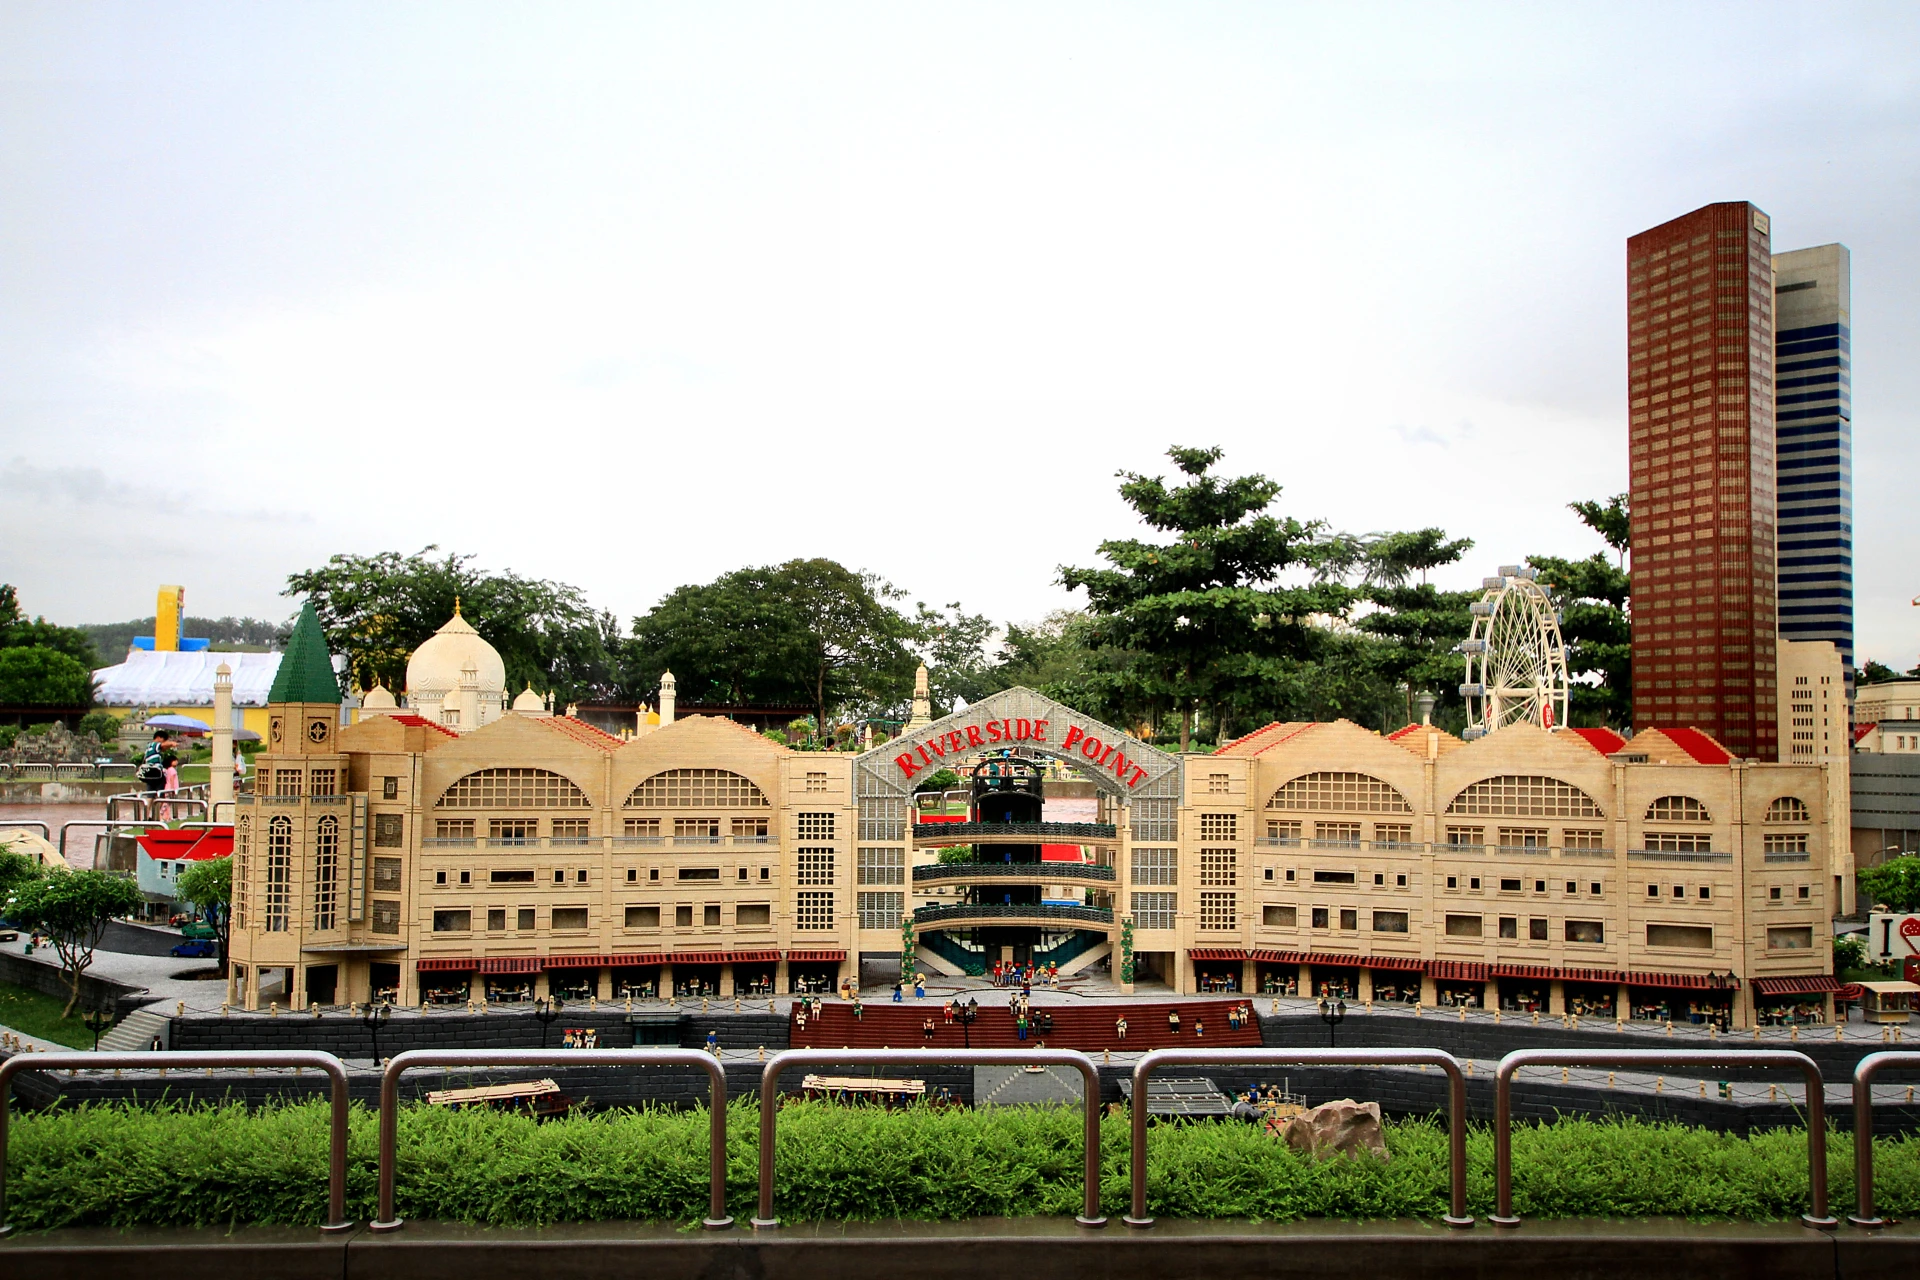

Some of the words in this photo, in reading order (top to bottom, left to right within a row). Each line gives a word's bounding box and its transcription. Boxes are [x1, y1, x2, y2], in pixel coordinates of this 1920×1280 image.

[894, 718, 1049, 780] RIVERSIDE
[1061, 725, 1149, 788] POINT
[1880, 918, 1894, 957] I
